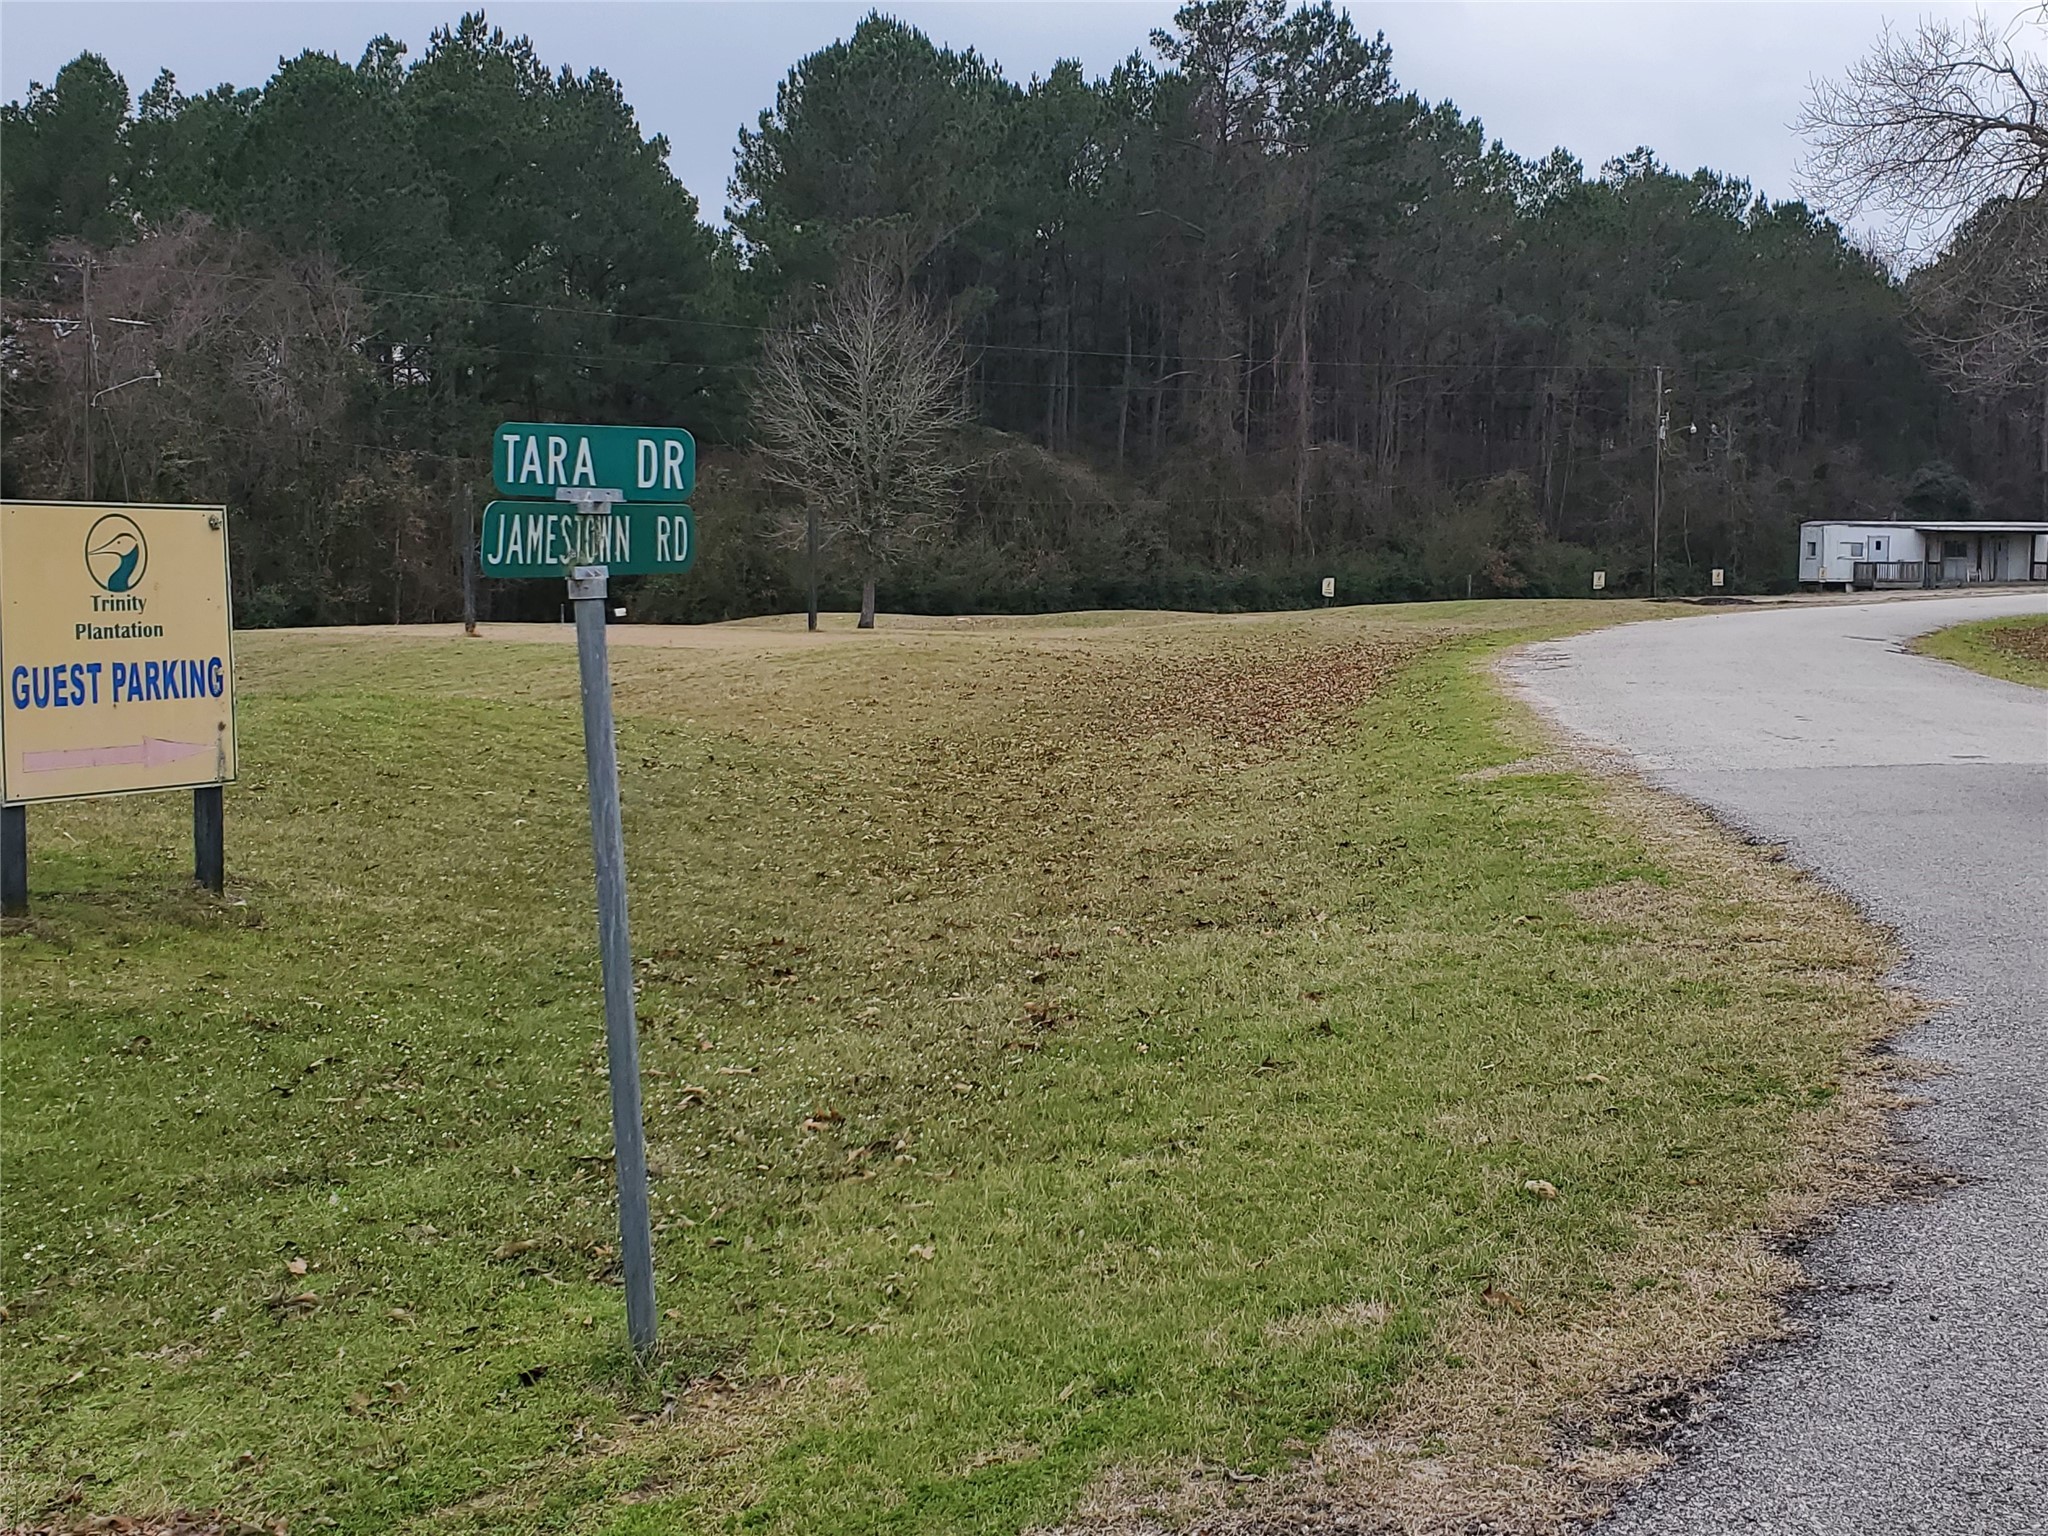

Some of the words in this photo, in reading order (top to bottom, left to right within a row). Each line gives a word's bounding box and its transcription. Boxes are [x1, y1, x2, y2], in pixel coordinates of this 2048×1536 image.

[502, 434, 597, 486] TARA
[637, 439, 685, 490] DR
[487, 514, 631, 565] JAMESTOWN
[657, 515, 689, 562] RD
[90, 594, 147, 615] Trinity
[75, 621, 164, 640] Plantation
[12, 662, 102, 710] GUEST
[112, 656, 224, 703] PARKING
